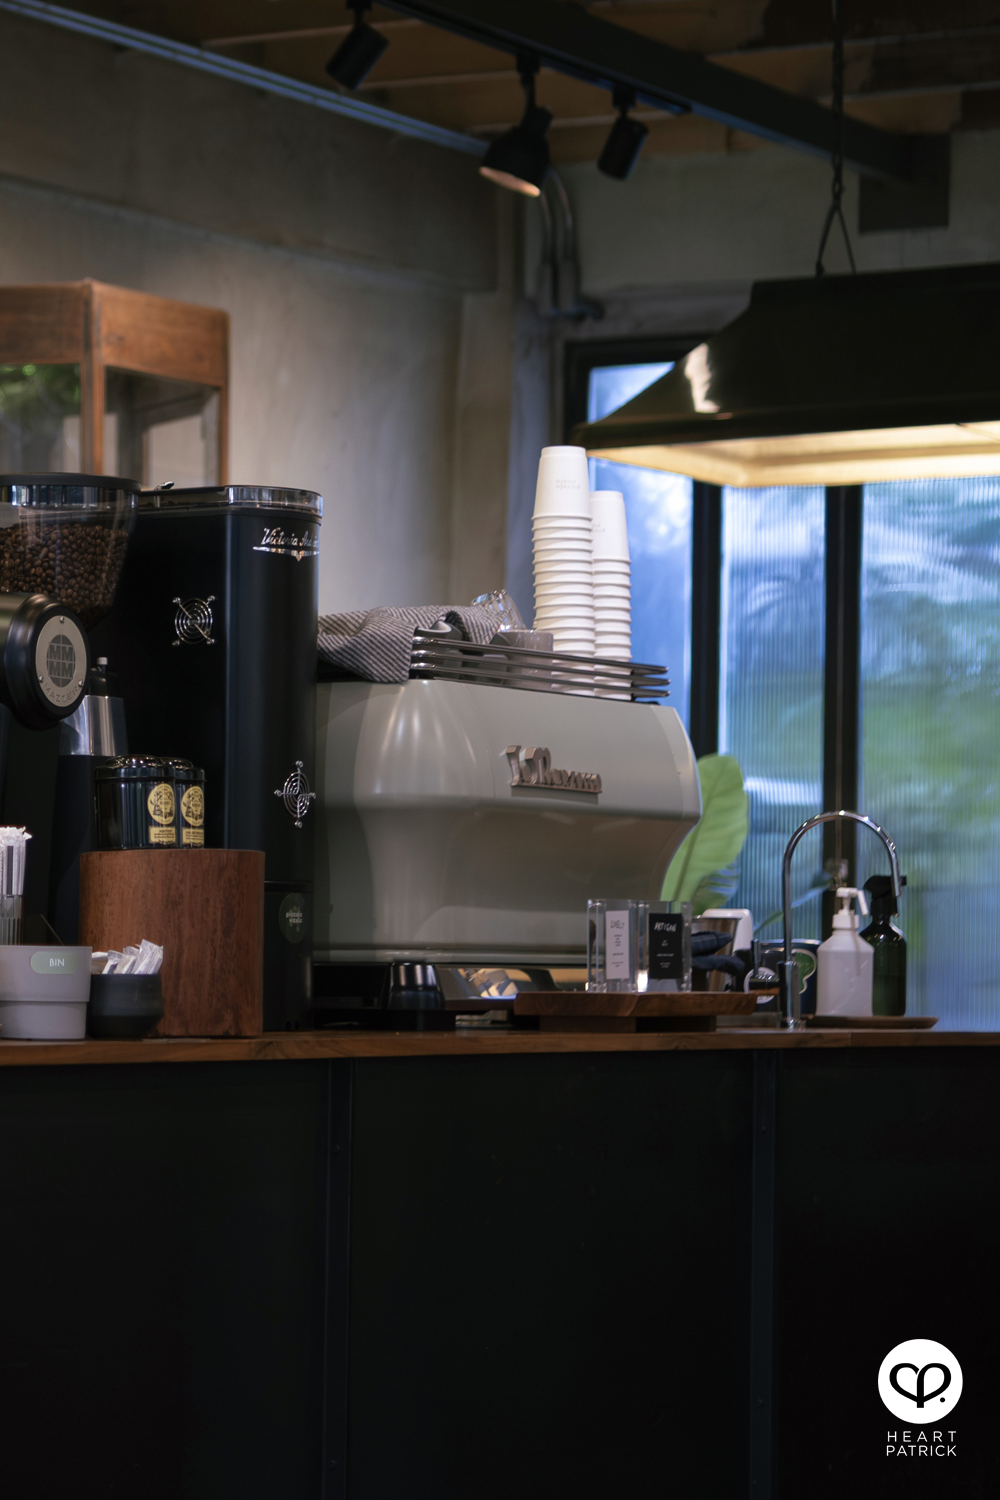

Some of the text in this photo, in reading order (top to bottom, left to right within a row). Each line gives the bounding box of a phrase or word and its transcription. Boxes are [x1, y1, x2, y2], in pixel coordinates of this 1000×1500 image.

[261, 527, 298, 546] Victoria
[43, 682, 79, 703] MAZZER
[50, 958, 65, 967] BIN
